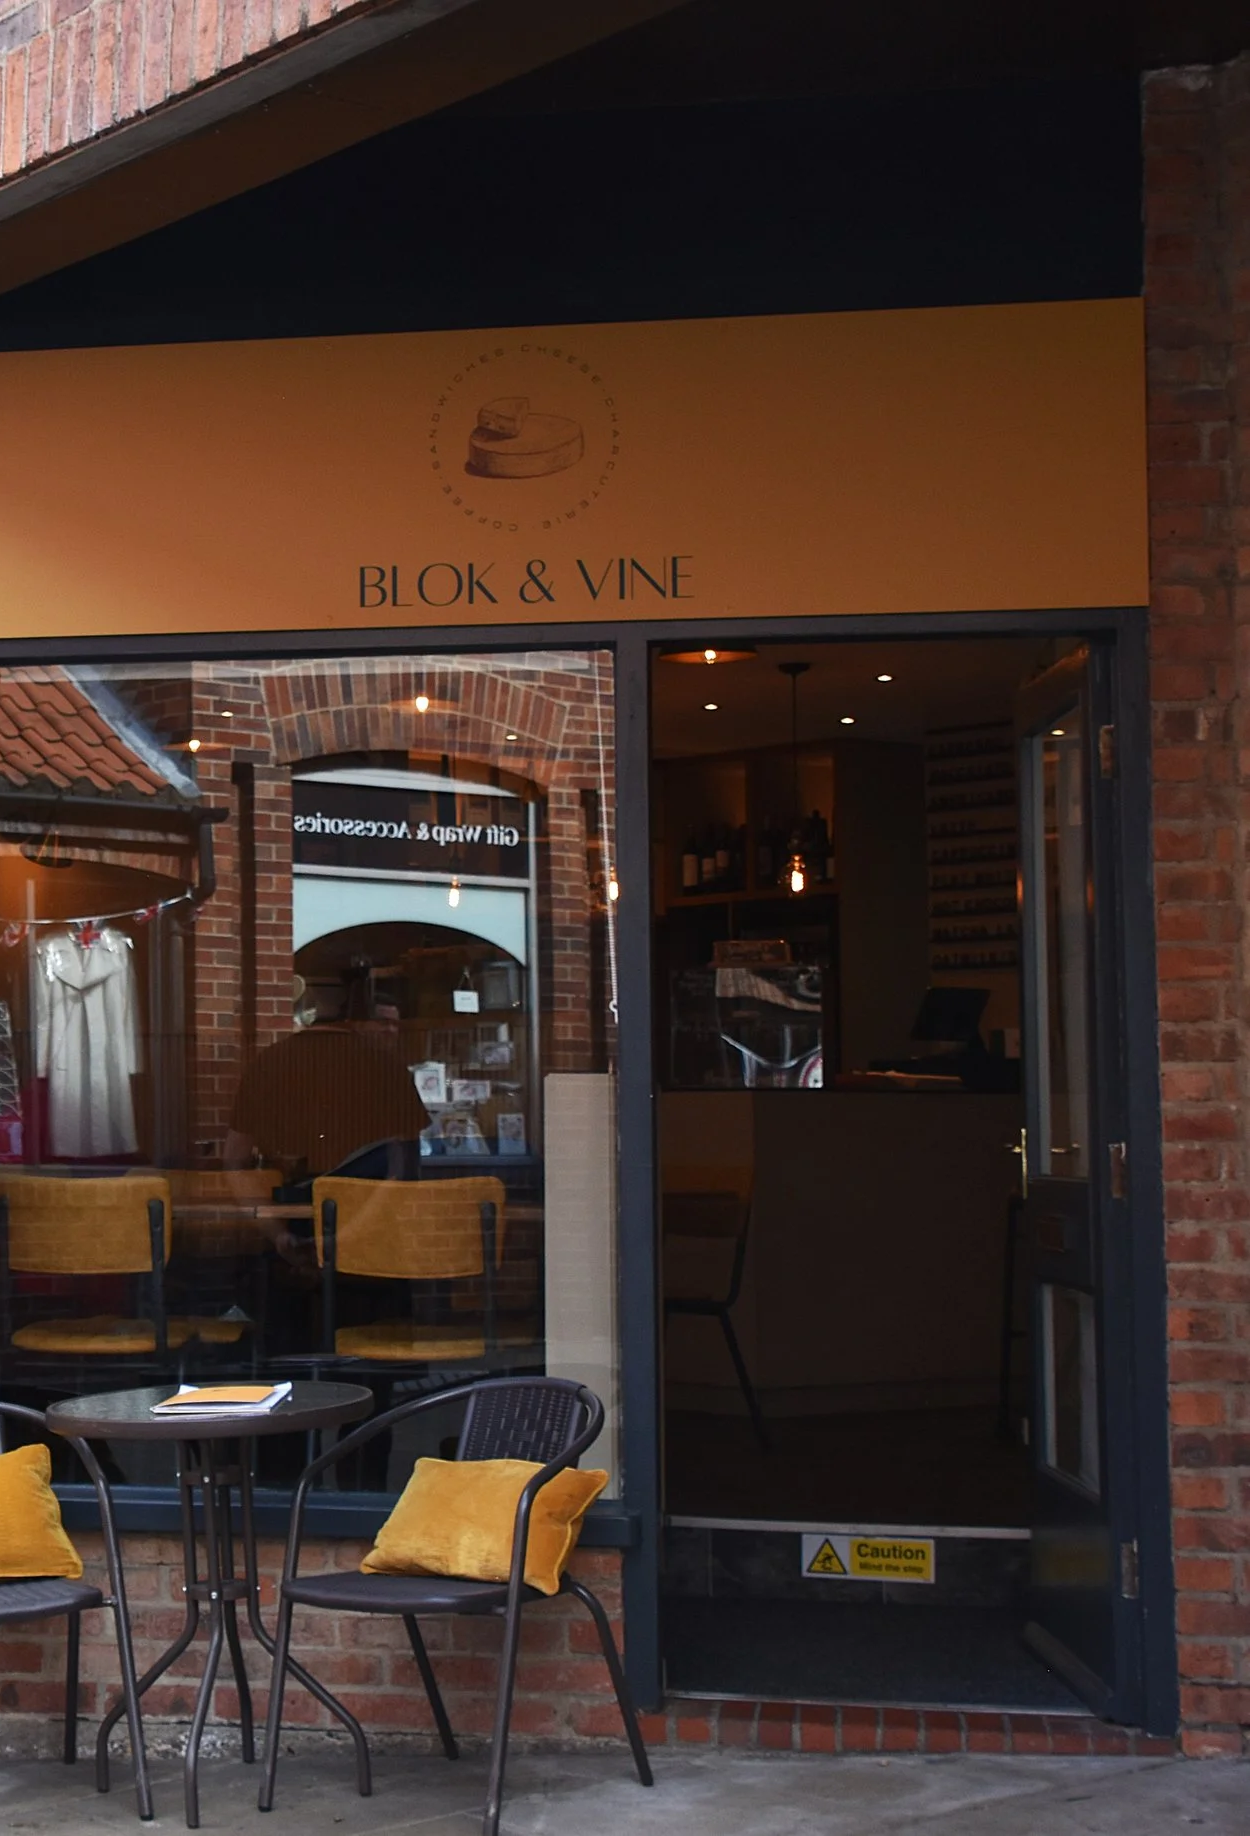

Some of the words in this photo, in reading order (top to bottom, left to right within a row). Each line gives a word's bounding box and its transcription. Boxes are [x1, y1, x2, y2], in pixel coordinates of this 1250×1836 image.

[359, 562, 499, 609] BLOK
[518, 558, 557, 605] &
[576, 555, 694, 601] VINE
[856, 1543, 926, 1561] Caution
